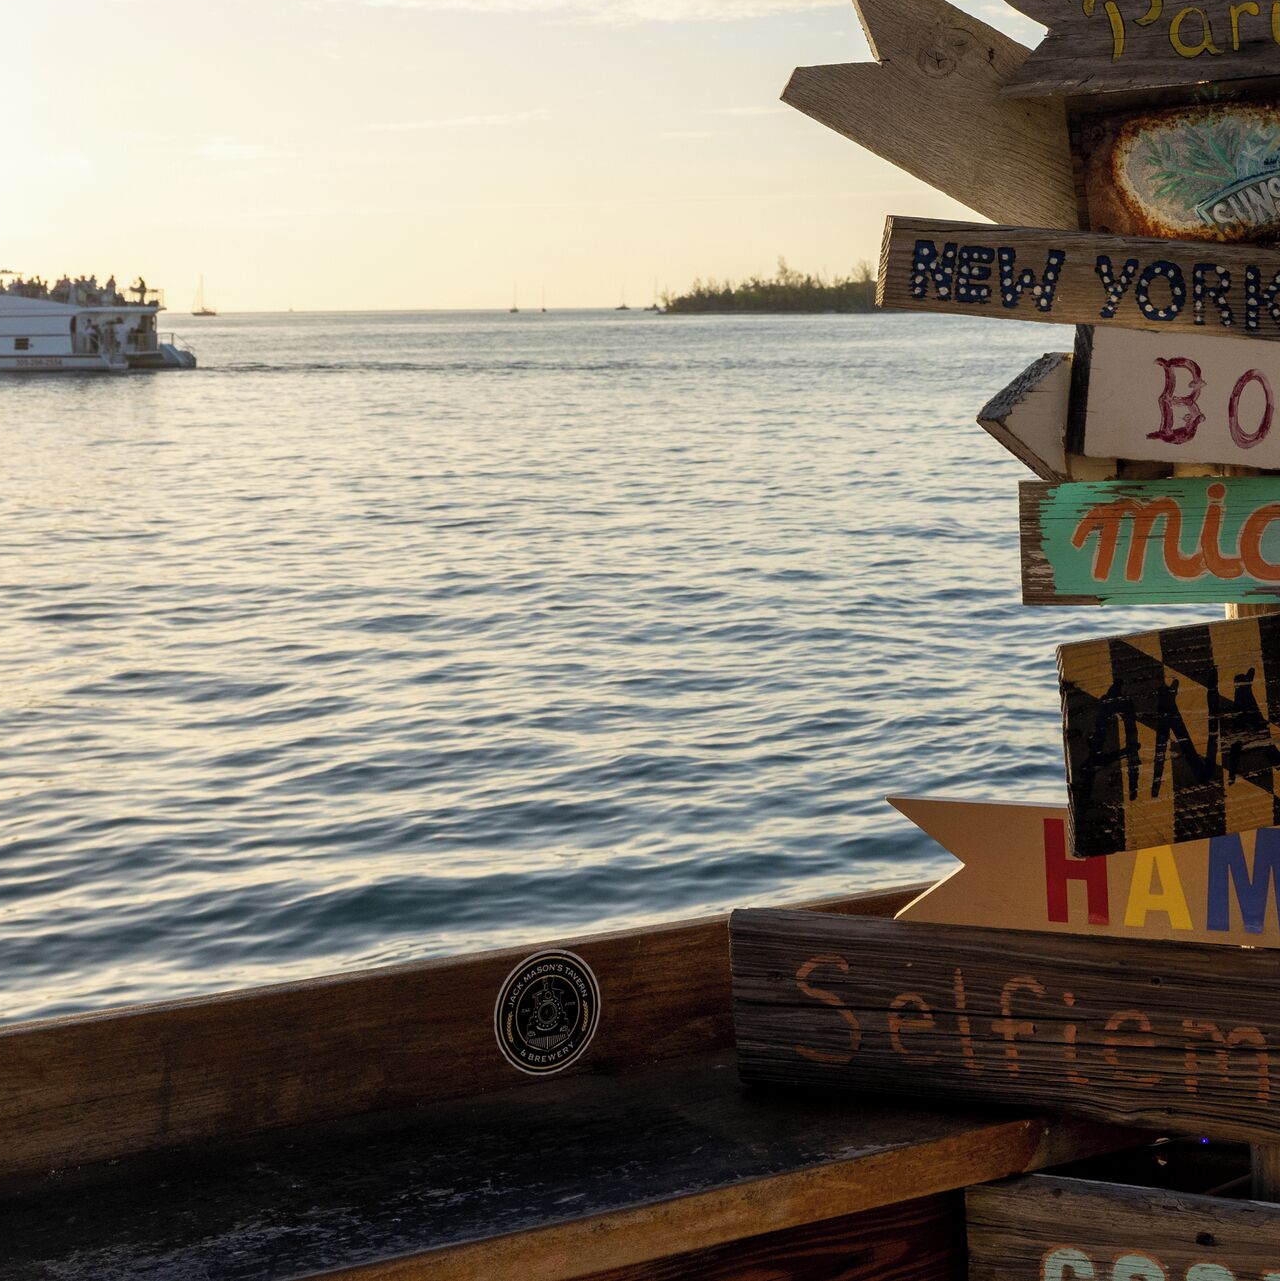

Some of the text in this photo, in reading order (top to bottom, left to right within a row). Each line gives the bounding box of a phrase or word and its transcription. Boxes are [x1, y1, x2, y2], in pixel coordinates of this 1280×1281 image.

[910, 239, 1067, 313] NEW
[507, 963, 588, 1009] JACK MASON'S TAVERN
[527, 1041, 575, 1063] BREWERY
